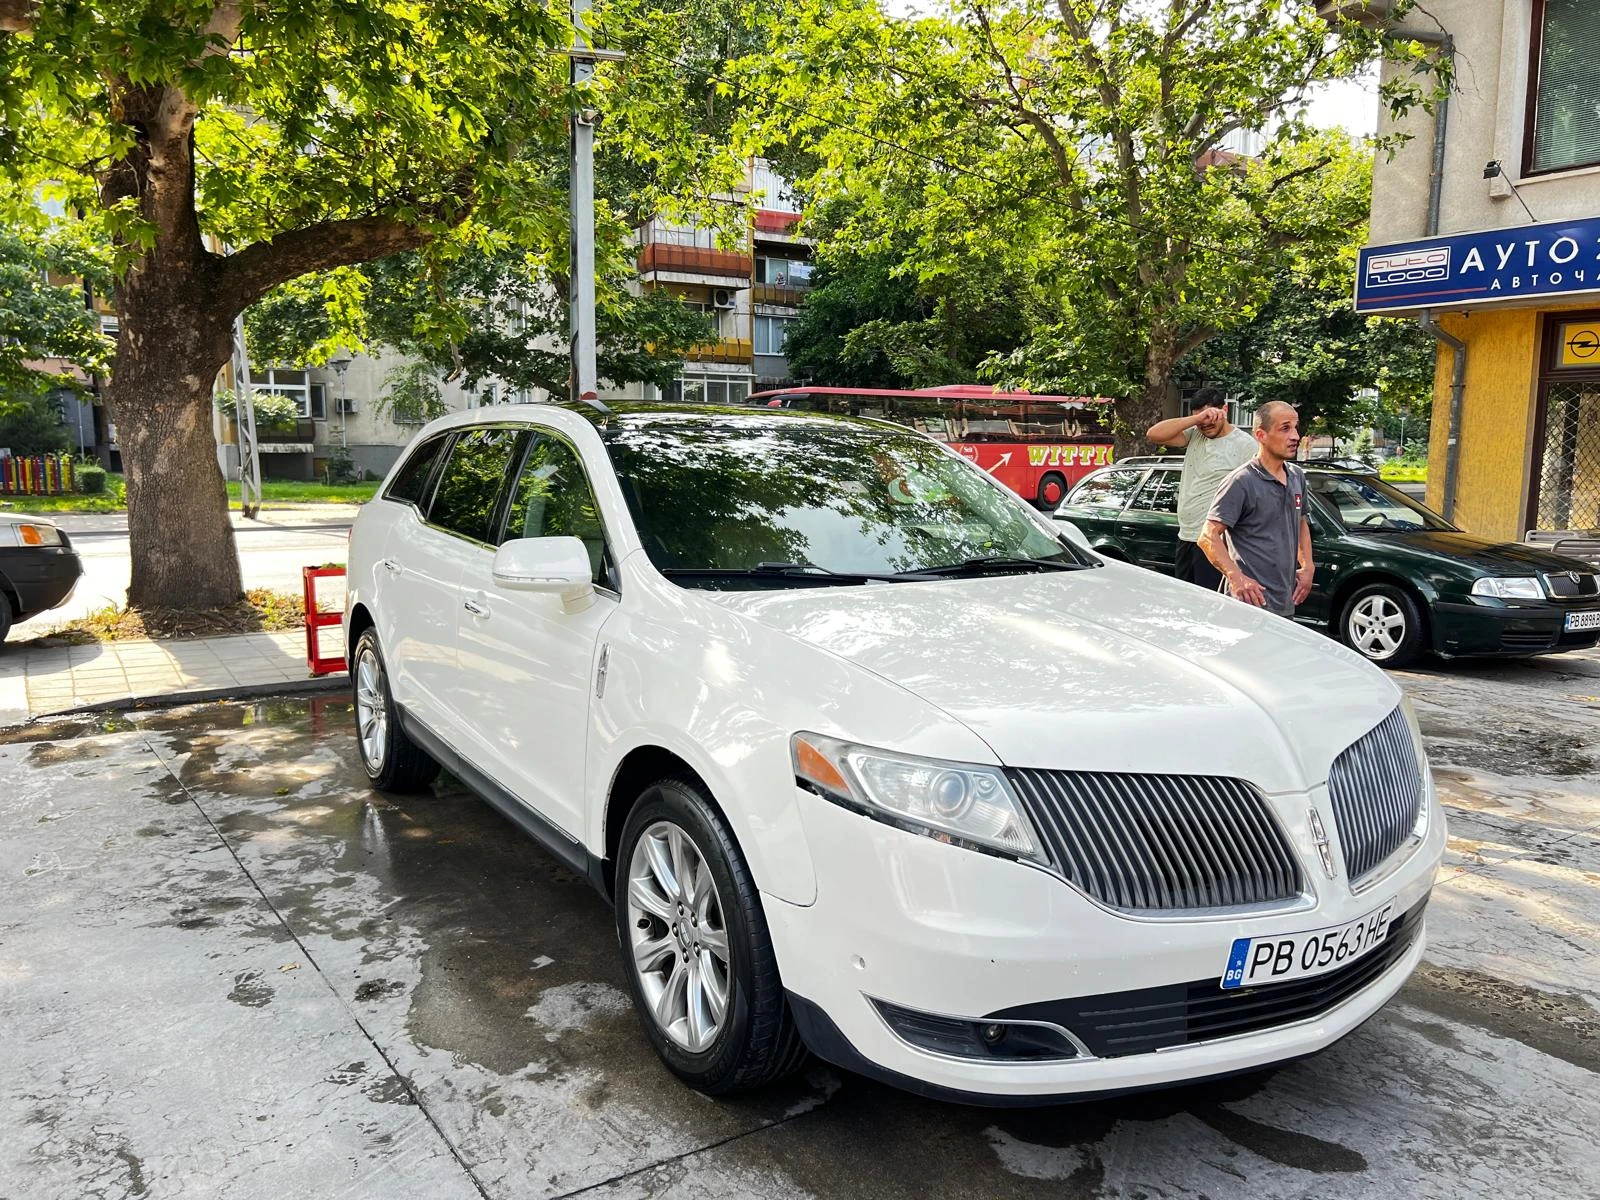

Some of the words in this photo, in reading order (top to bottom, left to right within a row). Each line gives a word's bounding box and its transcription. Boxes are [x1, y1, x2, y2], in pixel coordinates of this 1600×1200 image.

[1371, 254, 1446, 270] auto
[1459, 236, 1579, 274] АУТО
[1370, 267, 1446, 284] 2000
[1249, 940, 1295, 978] PB
[1301, 922, 1364, 970] 0563
[1364, 905, 1392, 948] HE
[1226, 969, 1242, 981] BG
